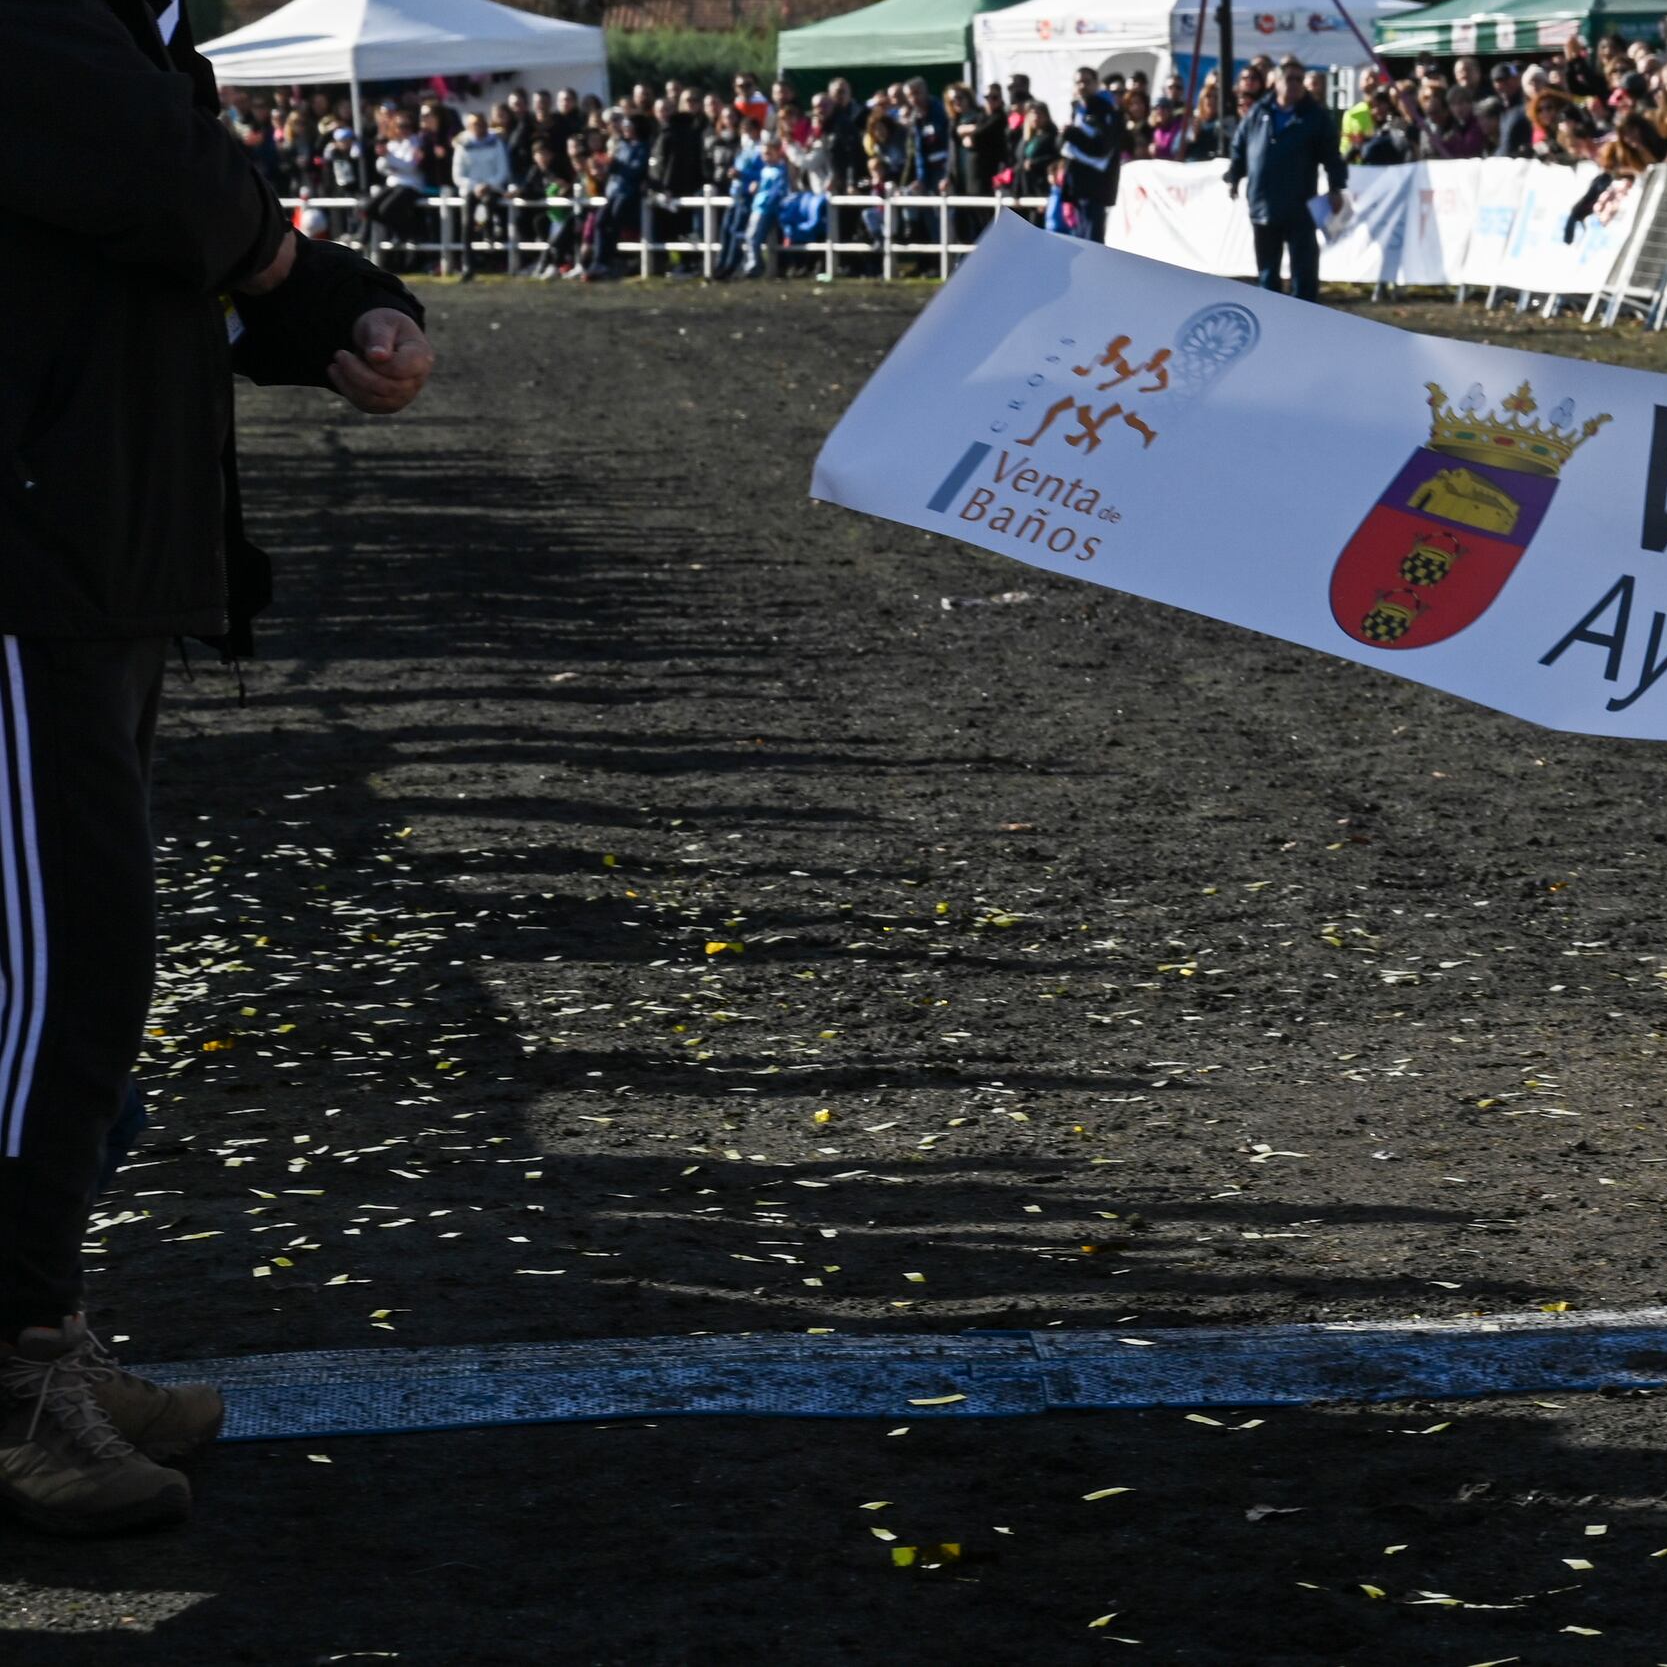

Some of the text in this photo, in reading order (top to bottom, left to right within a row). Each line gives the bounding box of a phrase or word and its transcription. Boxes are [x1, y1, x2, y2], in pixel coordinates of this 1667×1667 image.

[959, 486, 1103, 562] Baños
[993, 450, 1122, 524] Venta de
